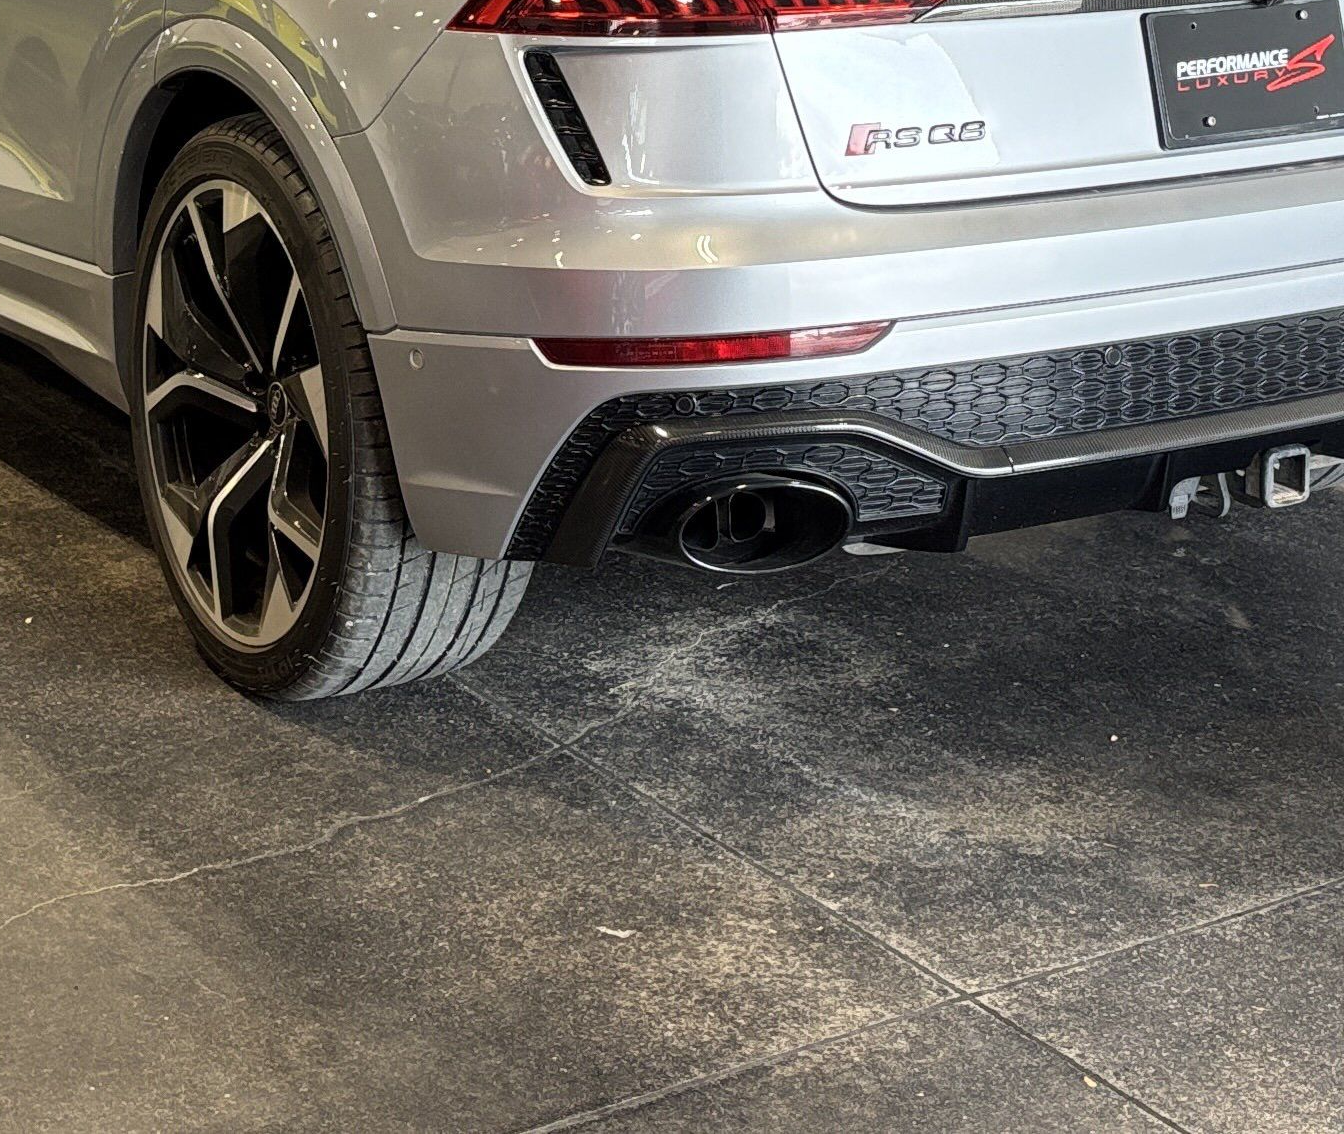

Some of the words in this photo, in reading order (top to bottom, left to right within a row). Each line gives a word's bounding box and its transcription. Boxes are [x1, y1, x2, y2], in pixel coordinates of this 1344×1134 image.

[1176, 48, 1289, 78] PERFORMANCE
[1177, 68, 1286, 92] LUXURY
[864, 127, 923, 153] RS
[928, 120, 986, 144] Q8
